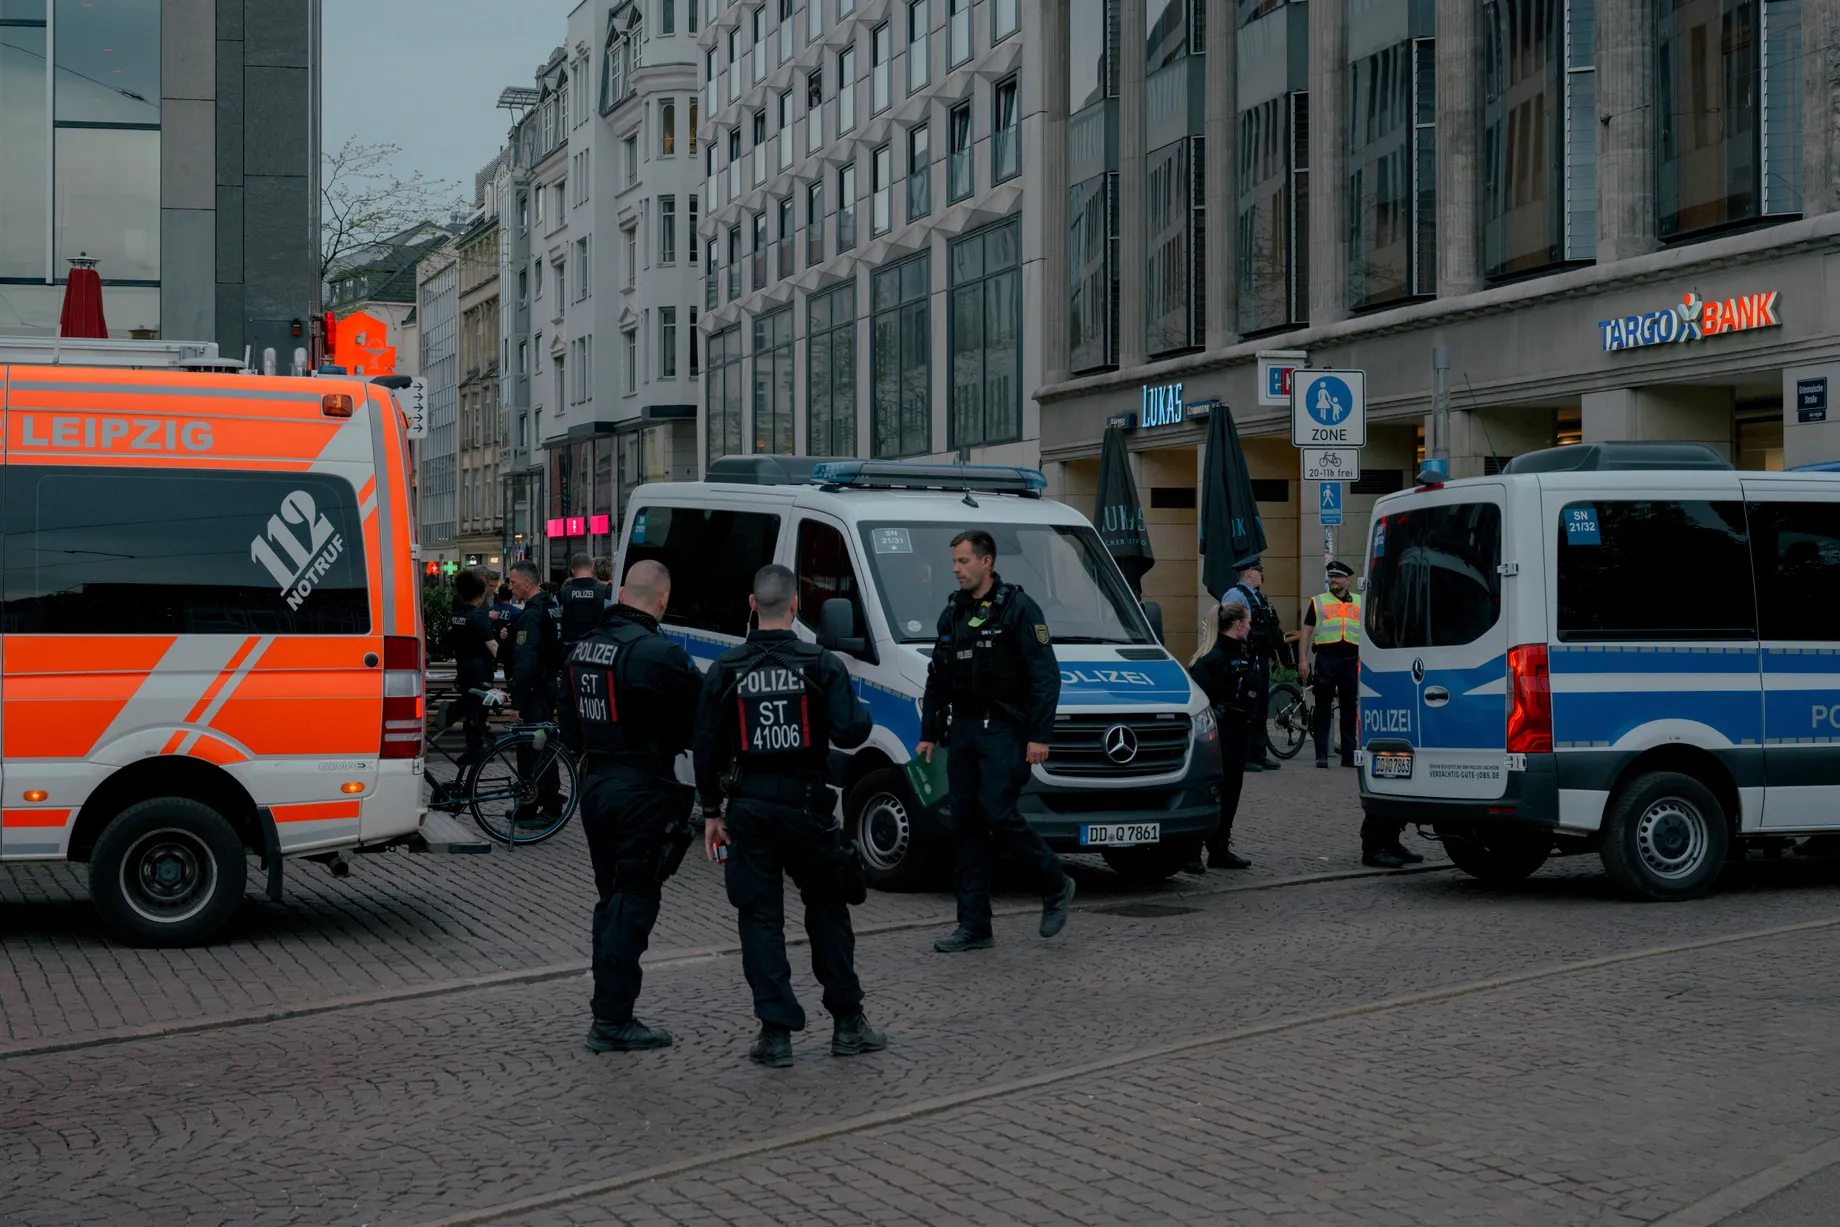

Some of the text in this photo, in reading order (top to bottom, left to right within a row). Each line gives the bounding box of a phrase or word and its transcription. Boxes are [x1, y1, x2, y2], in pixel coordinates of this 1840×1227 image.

[1142, 383, 1183, 429] LUKAS
[22, 415, 214, 452] LEIPZIG
[1311, 429, 1347, 441] ZONE
[1309, 468, 1353, 478] 20-11h frei
[1570, 522, 1596, 532] 21/32
[1573, 511, 1588, 521] SN
[251, 490, 335, 597] 112
[286, 533, 343, 612] NOTRUF
[571, 590, 594, 599] POLIZEI
[572, 642, 619, 666] POLIZEI
[581, 672, 598, 695] ST
[737, 667, 806, 694] POLIZEI
[1060, 670, 1155, 686] OLIZEI
[579, 698, 608, 721] 41001
[759, 700, 788, 726] ST
[1364, 709, 1412, 732] POLIZEI
[752, 724, 801, 750] 41006
[1090, 825, 1158, 842] DD Q 7861
